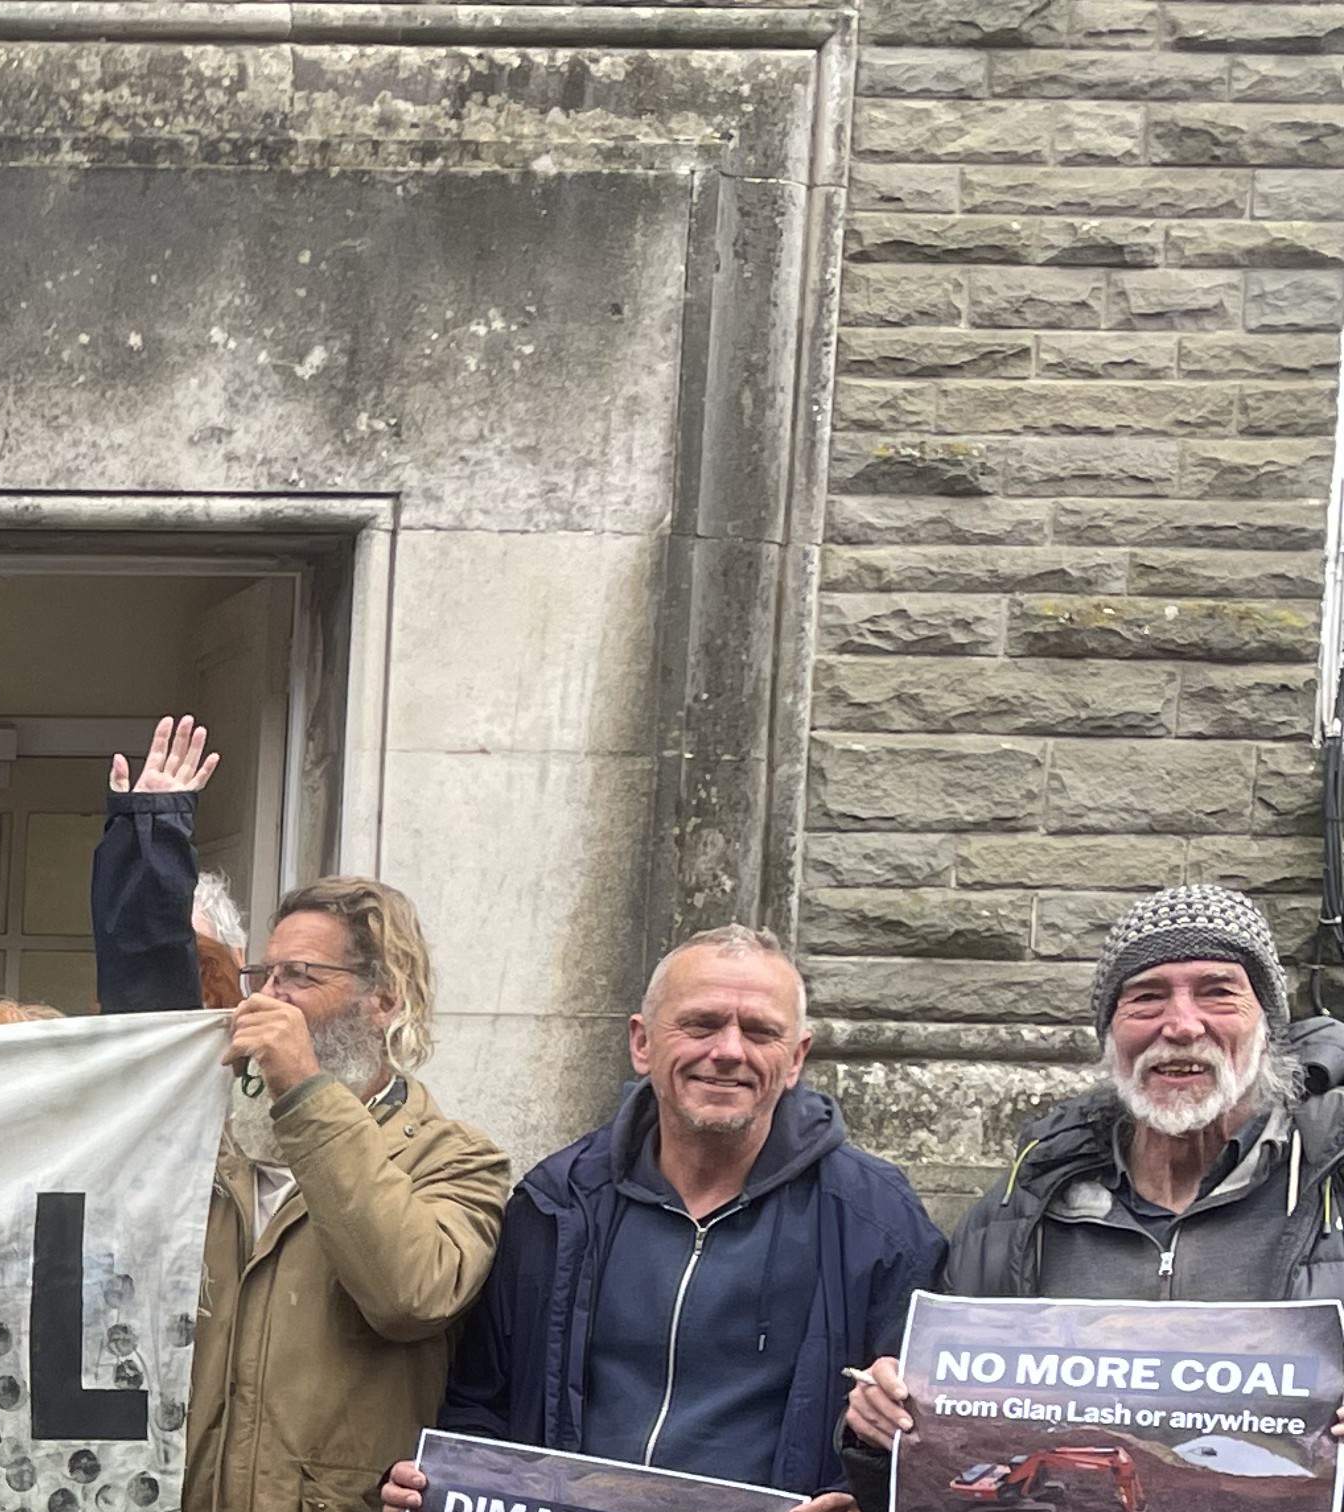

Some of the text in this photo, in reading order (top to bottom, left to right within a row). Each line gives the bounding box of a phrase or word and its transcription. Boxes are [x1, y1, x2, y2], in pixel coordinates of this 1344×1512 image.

[935, 1350, 1310, 1397] NO MORE COAL
[935, 1394, 1305, 1436] from Glan Lash or anywhere
